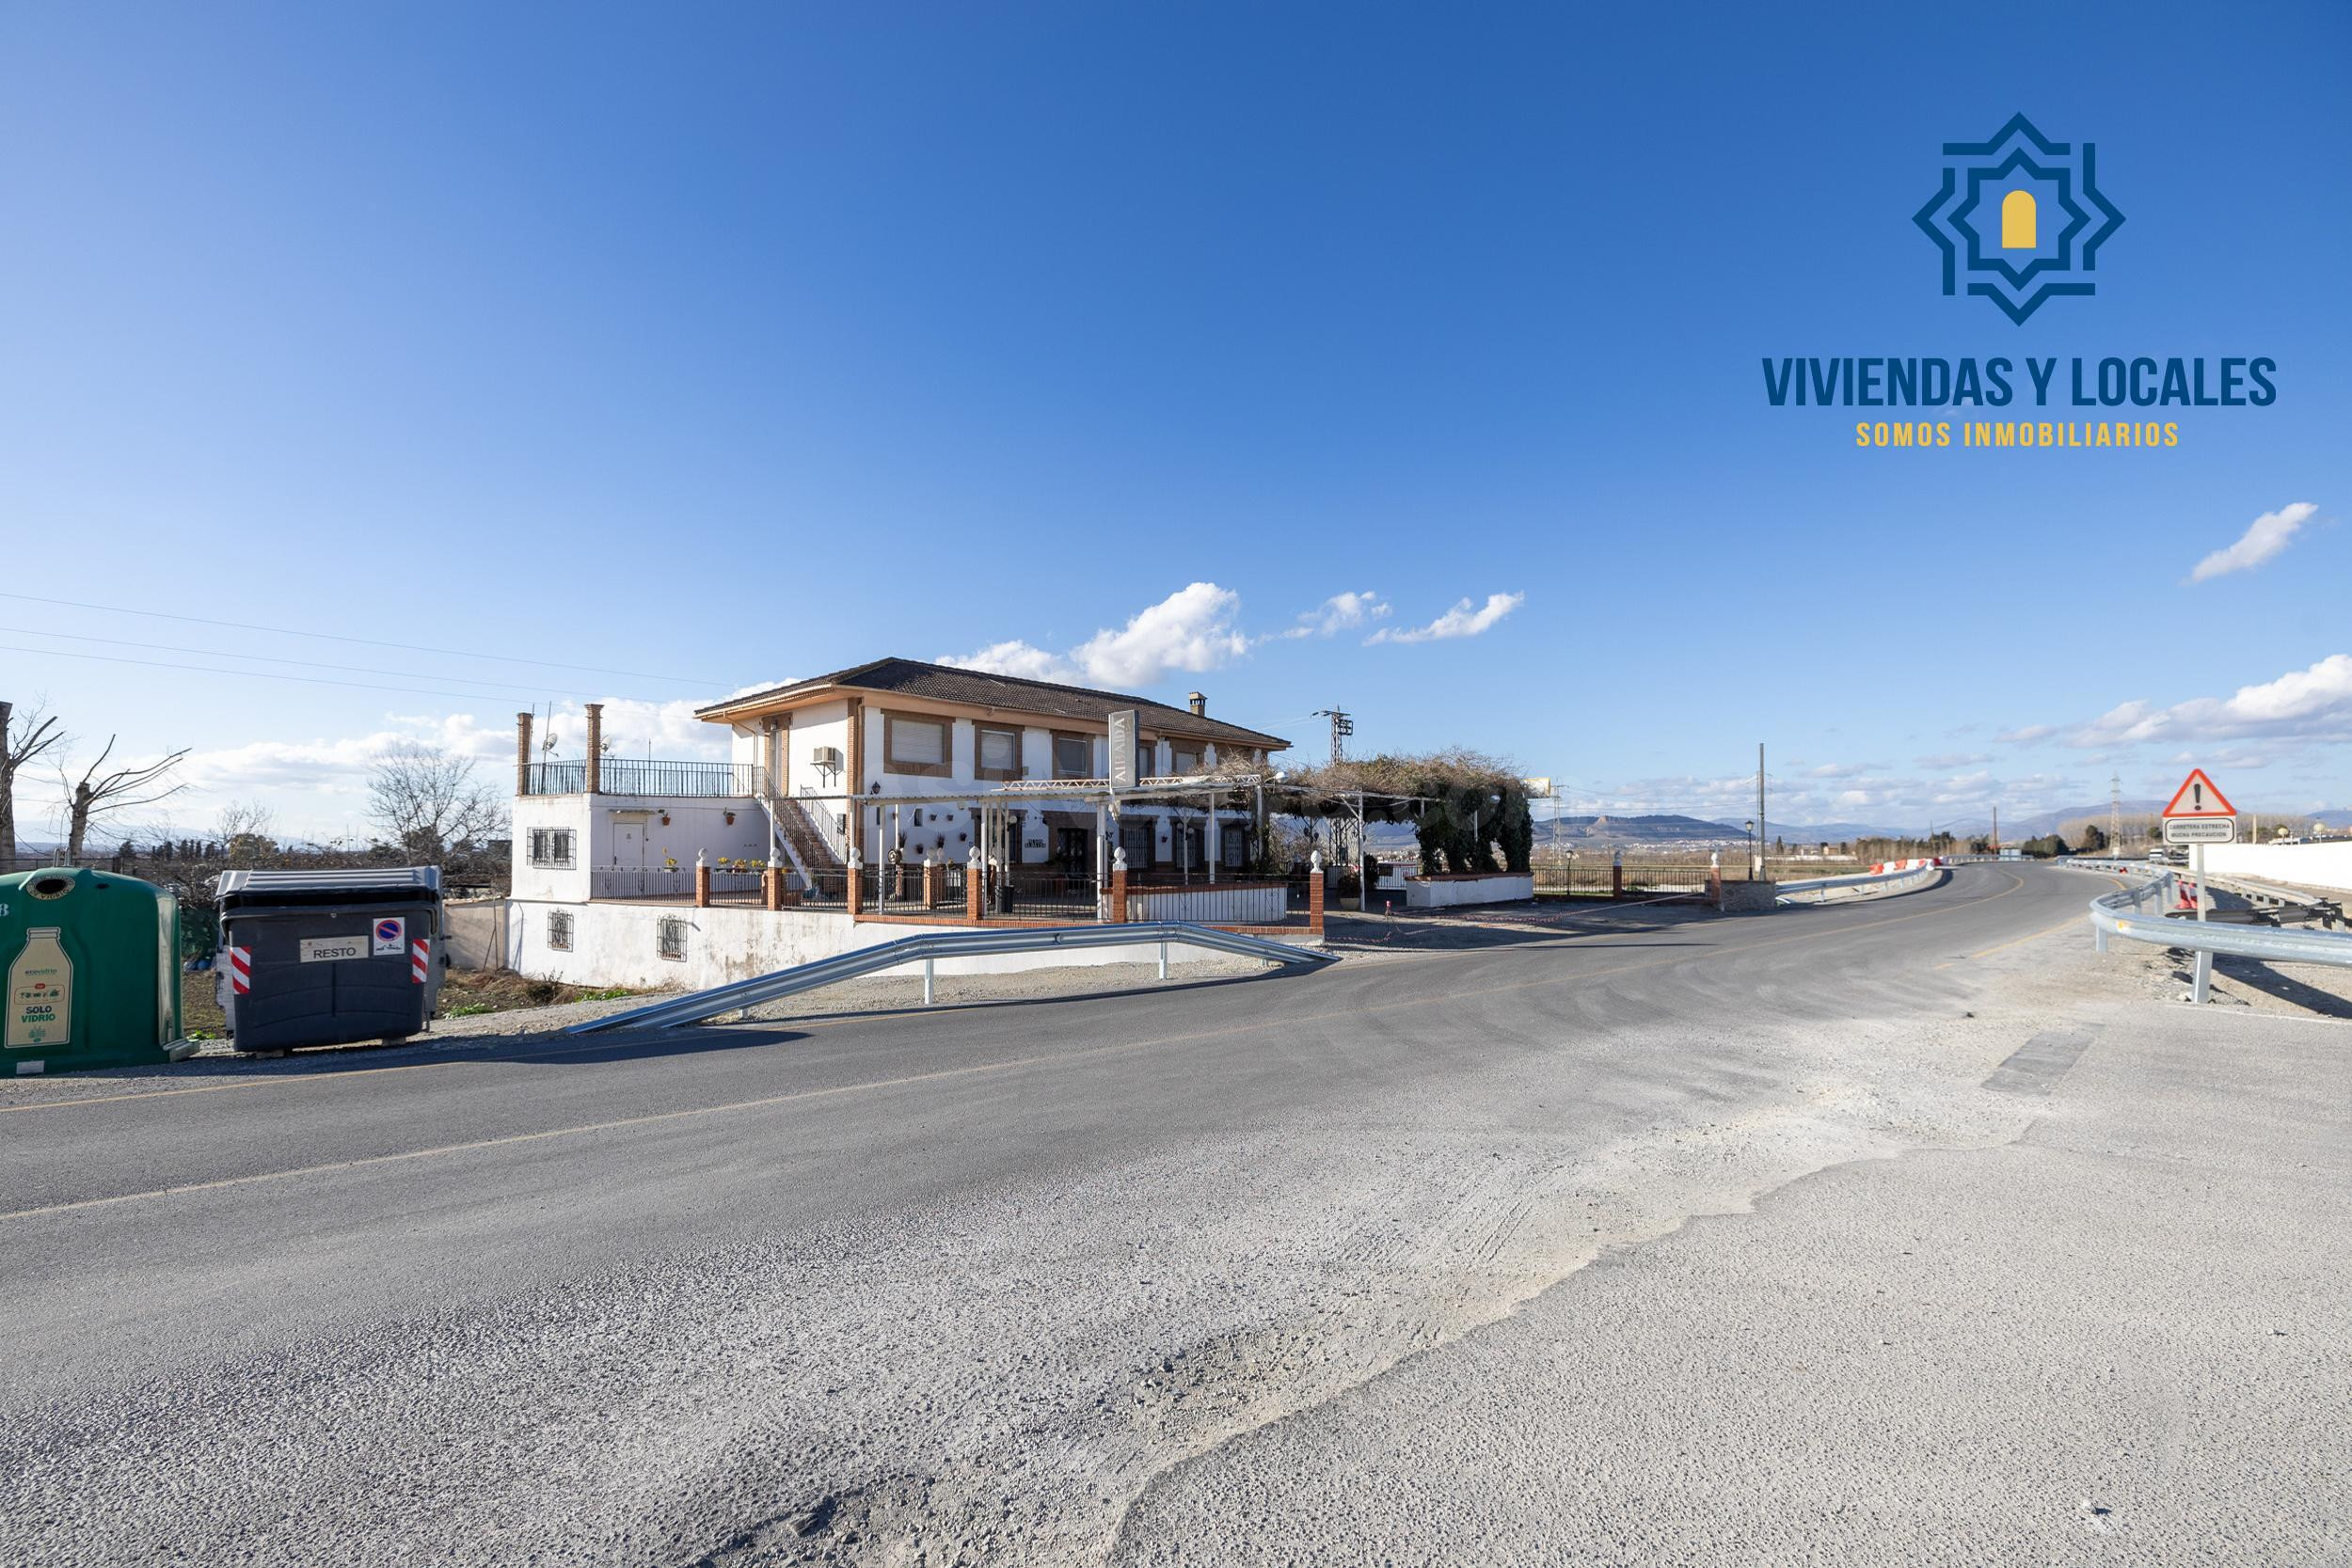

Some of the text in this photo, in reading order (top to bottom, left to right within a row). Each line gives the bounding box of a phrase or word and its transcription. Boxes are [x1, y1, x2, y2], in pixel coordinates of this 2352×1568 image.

[313, 946, 357, 958] RESTO
[25, 1006, 53, 1014] SOLO
[21, 1014, 56, 1023] VIDRIO
